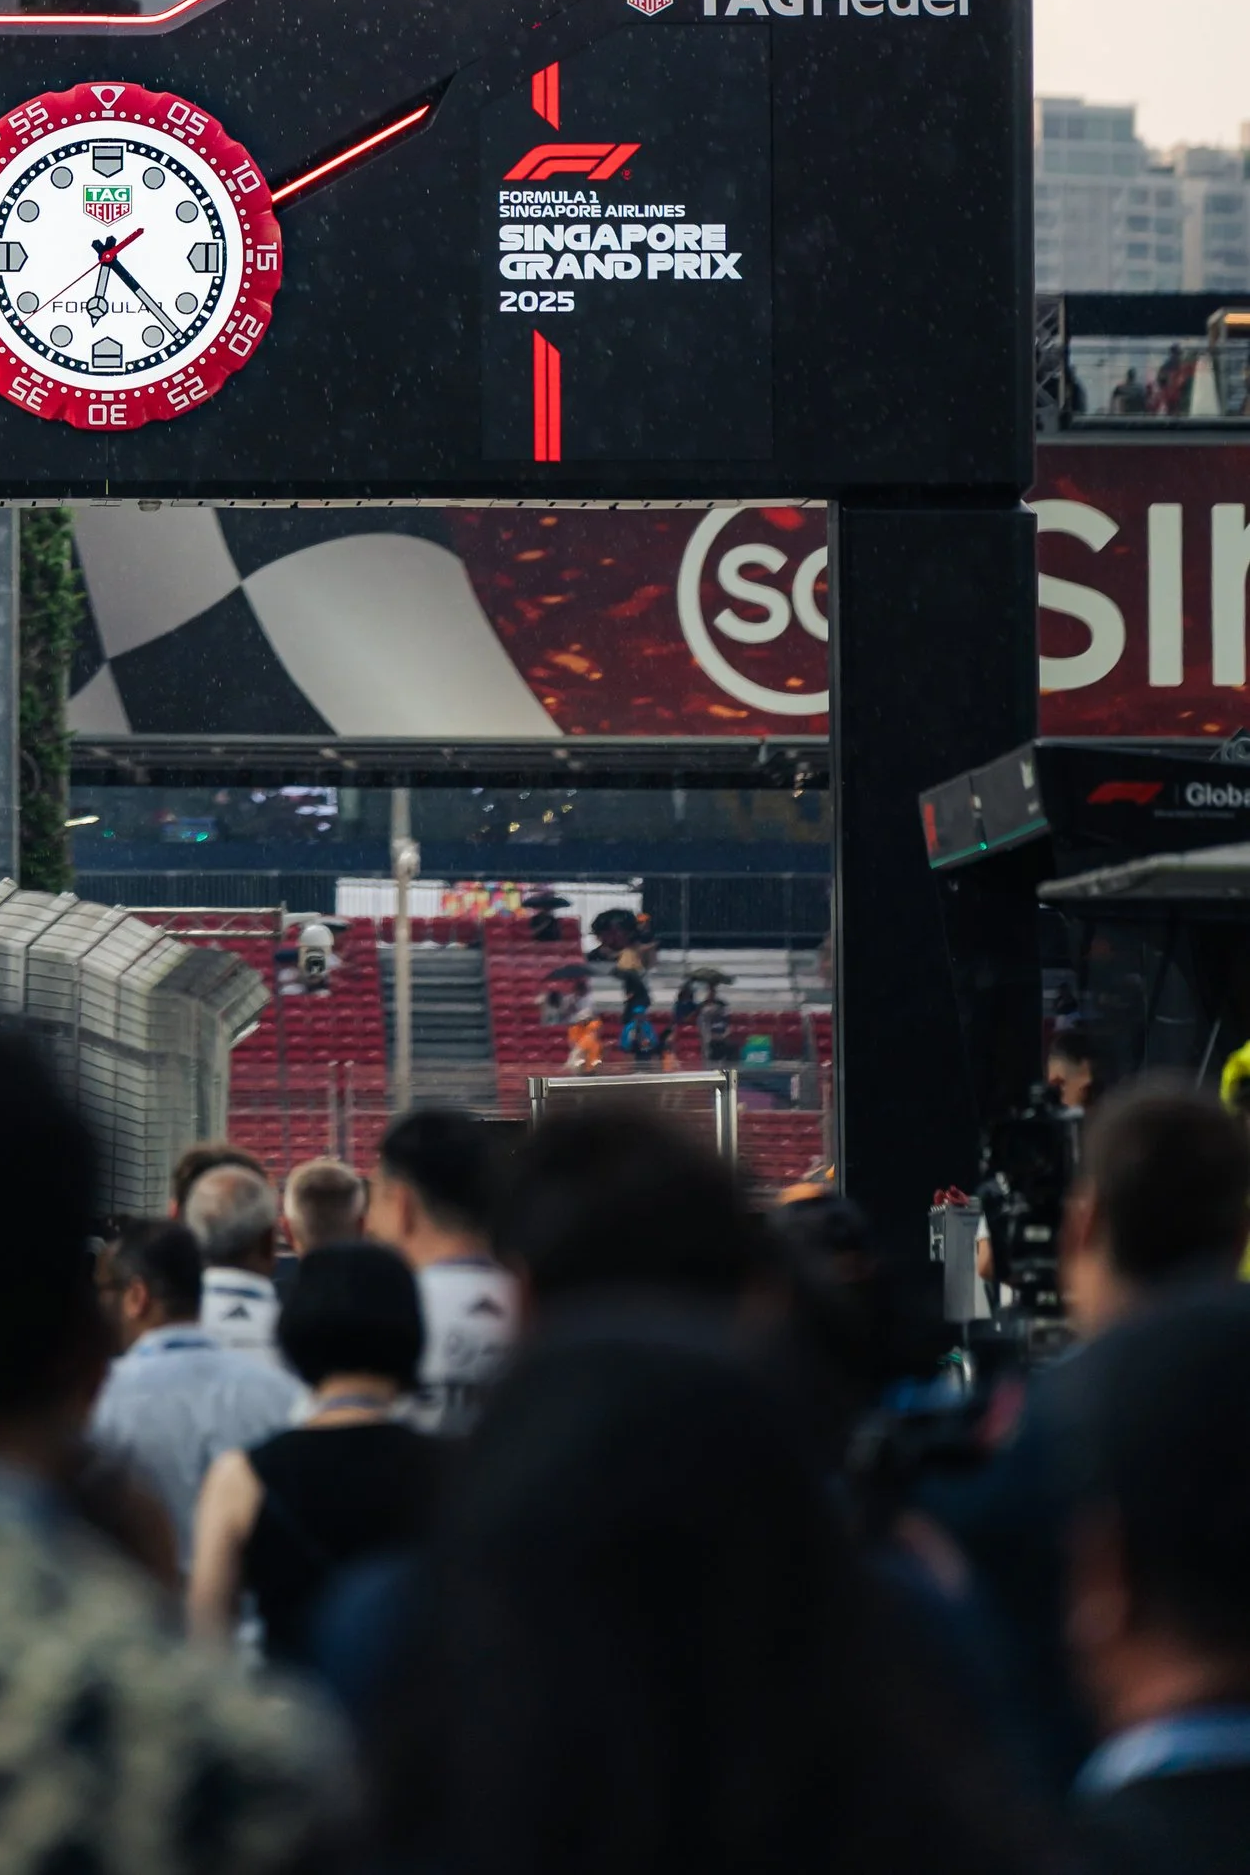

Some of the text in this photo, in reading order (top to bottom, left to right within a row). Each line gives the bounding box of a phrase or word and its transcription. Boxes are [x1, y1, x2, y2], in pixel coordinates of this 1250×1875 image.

[8, 101, 49, 135] 55
[167, 101, 209, 136] 05
[231, 160, 261, 193] 10
[88, 188, 128, 201] TAG
[500, 191, 600, 204] FORMULA 1
[87, 203, 129, 223] HEUER
[499, 205, 686, 218] SINGAPORE AIRLINES
[499, 223, 727, 252] SINGAPORE
[257, 242, 277, 271] 15
[499, 253, 743, 280] GRAND PRIX
[500, 291, 575, 312] 2025
[229, 314, 264, 356] 20
[8, 377, 49, 411] 35
[167, 377, 208, 411] 25
[88, 404, 127, 426] 30
